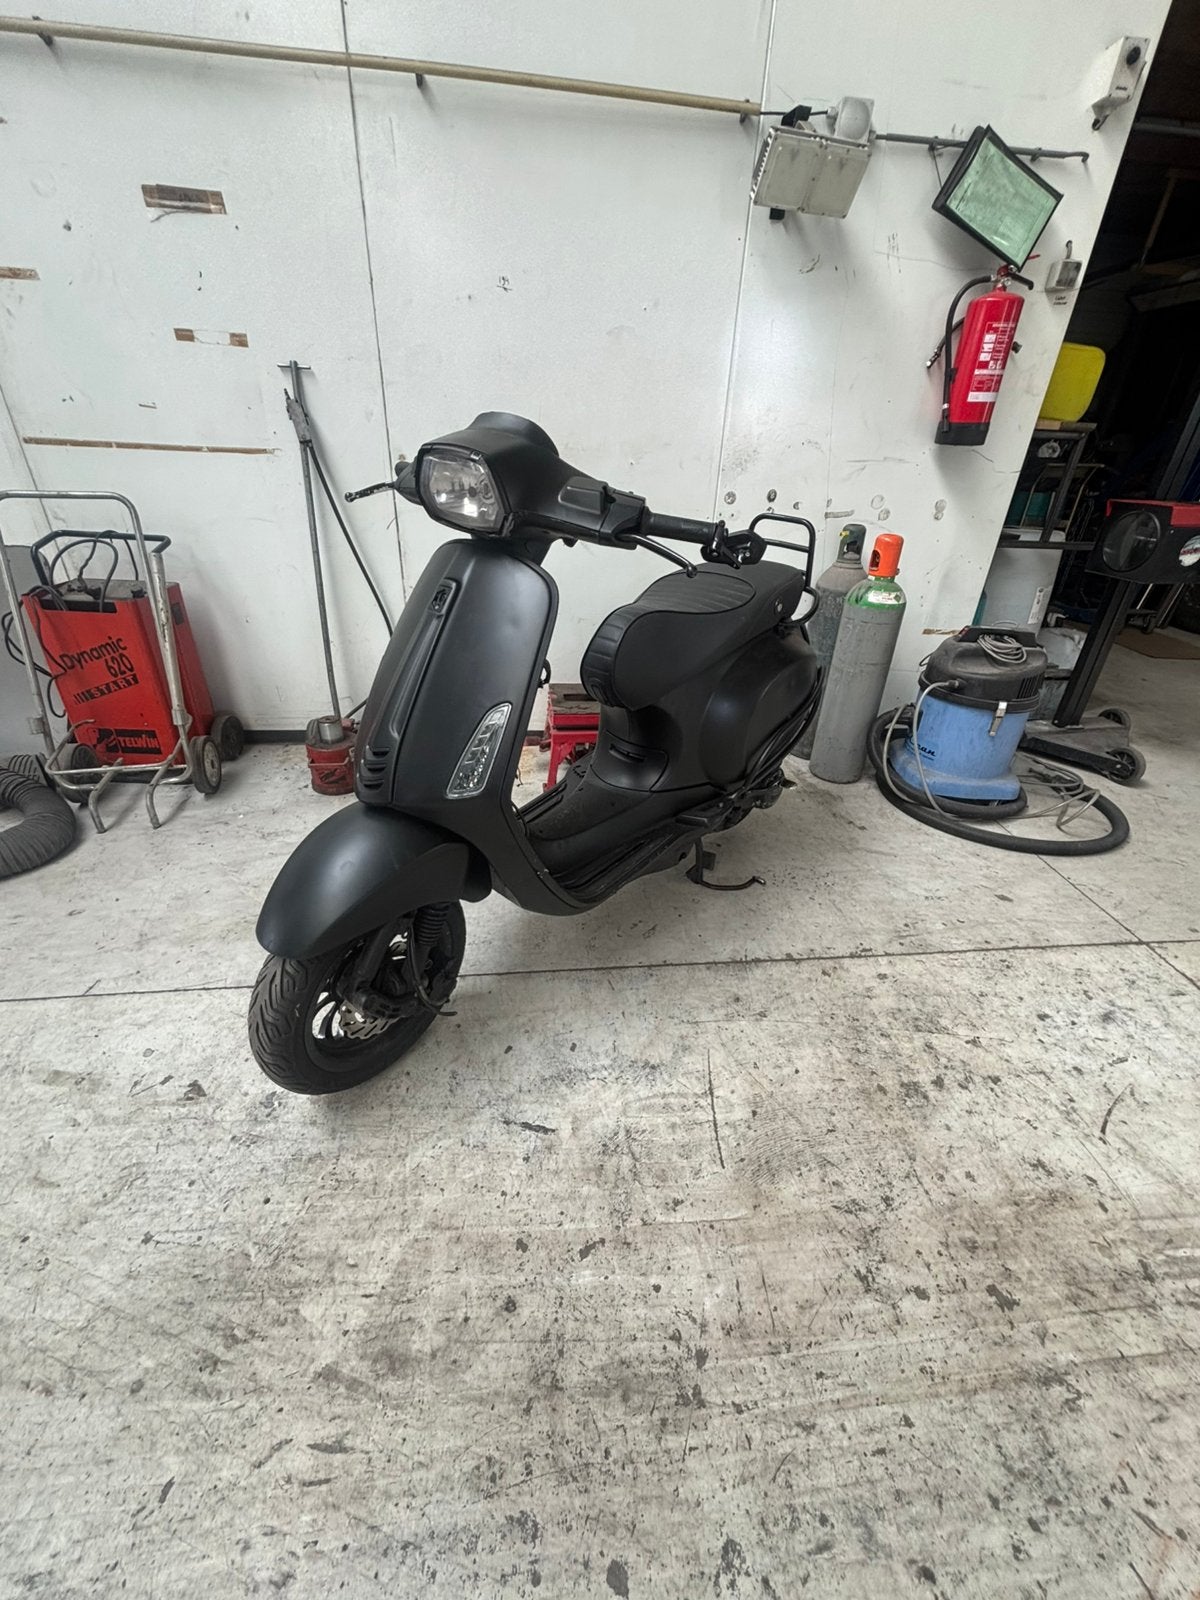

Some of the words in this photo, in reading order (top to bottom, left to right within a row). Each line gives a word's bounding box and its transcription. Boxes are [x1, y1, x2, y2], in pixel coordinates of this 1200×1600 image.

[59, 636, 127, 670] Dynamic
[104, 653, 134, 678] 620
[93, 674, 139, 699] START
[117, 734, 160, 748] TELWIN
